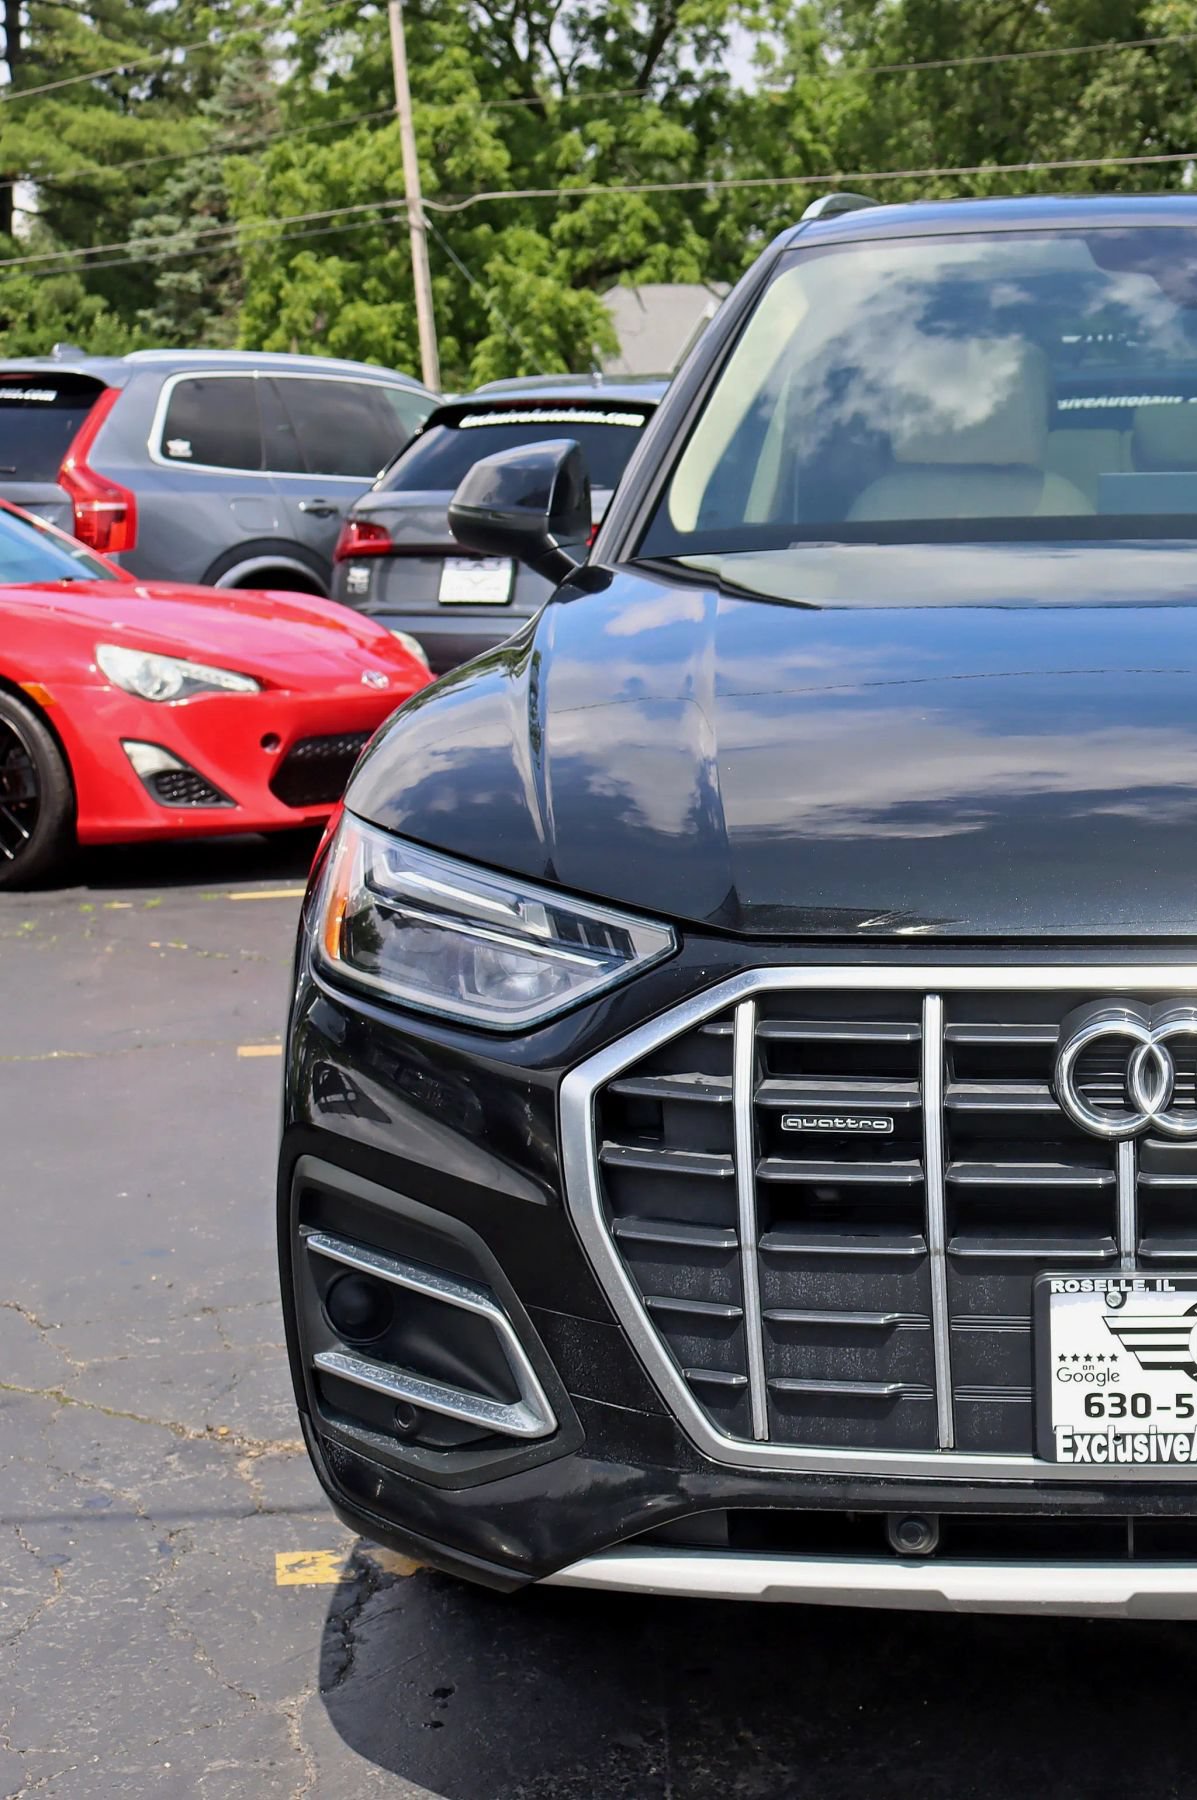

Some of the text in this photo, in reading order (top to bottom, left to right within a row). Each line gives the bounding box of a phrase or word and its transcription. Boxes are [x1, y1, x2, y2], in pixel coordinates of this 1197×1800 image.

[786, 1118, 888, 1129] quattro
[1050, 1279, 1176, 1293] ROSELLE, IL
[1056, 1366, 1120, 1387] Google
